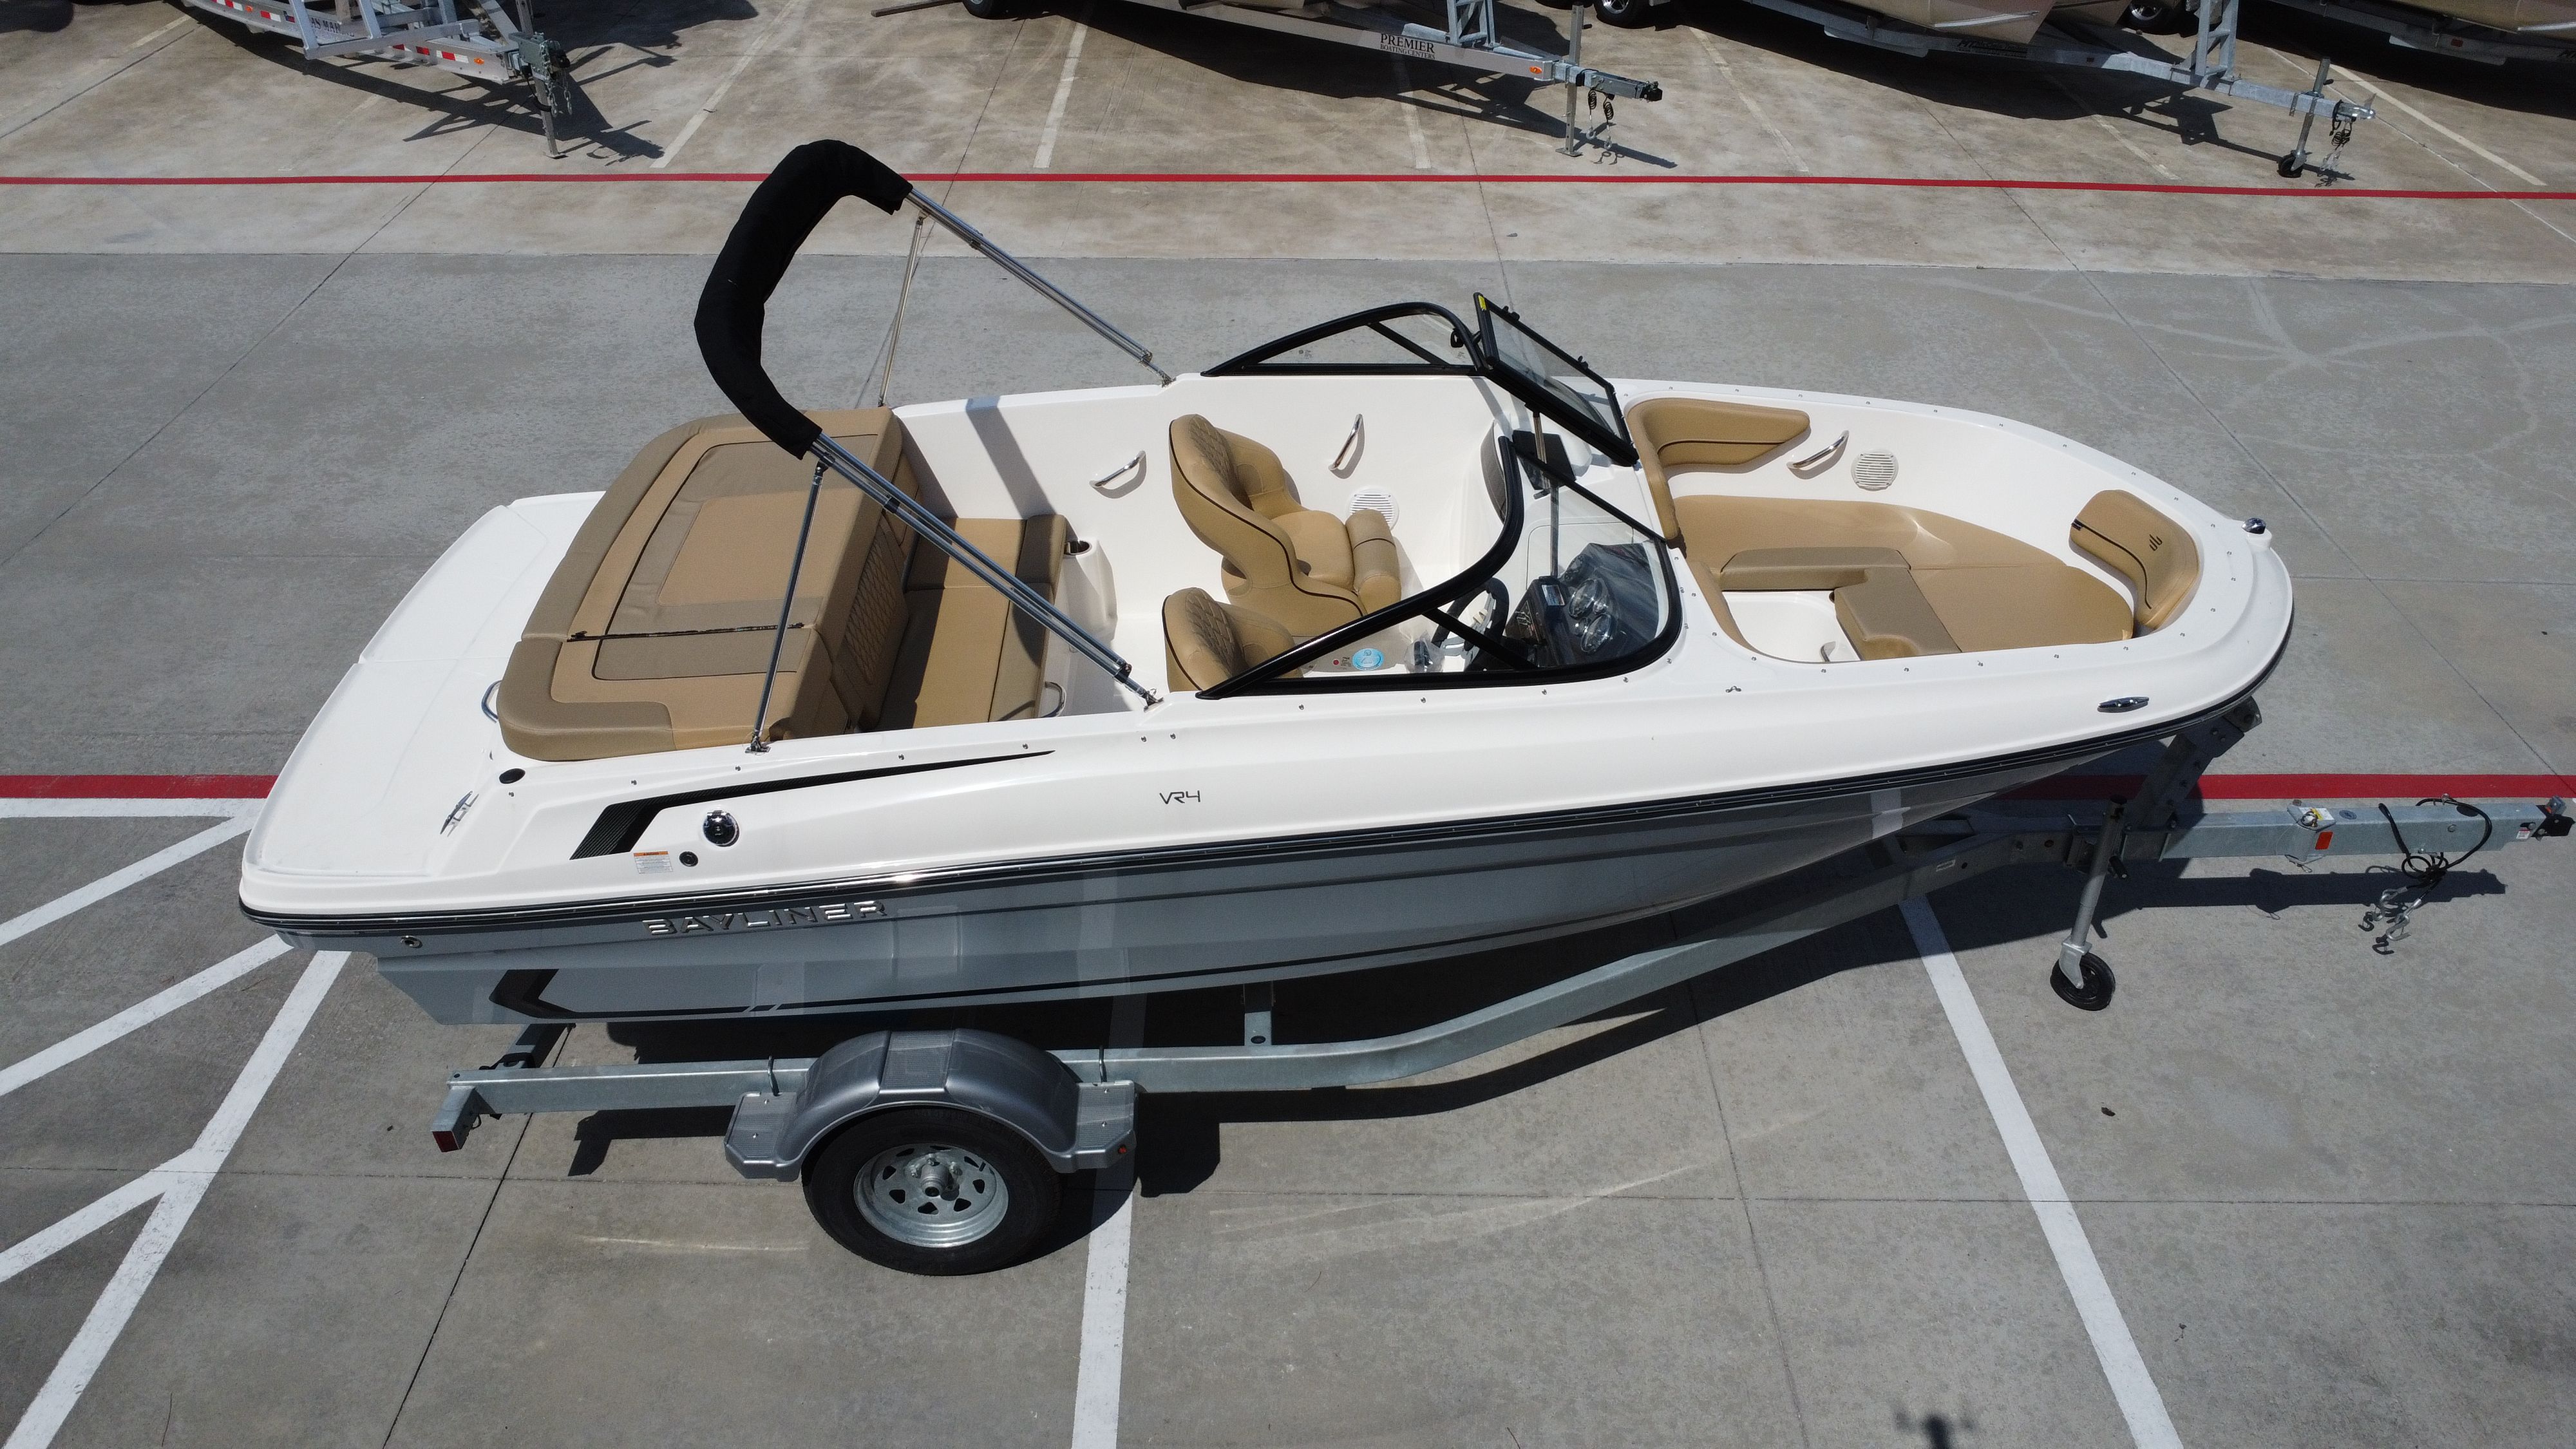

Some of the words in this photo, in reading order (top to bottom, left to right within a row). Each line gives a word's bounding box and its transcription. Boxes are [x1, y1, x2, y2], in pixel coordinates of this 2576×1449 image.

[1380, 44, 1407, 54] BOATING
[1408, 49, 1435, 59] CENTERS
[1381, 33, 1435, 53] PREMIER
[1159, 790, 1200, 804] VR4
[642, 900, 887, 935] BAYLINER
